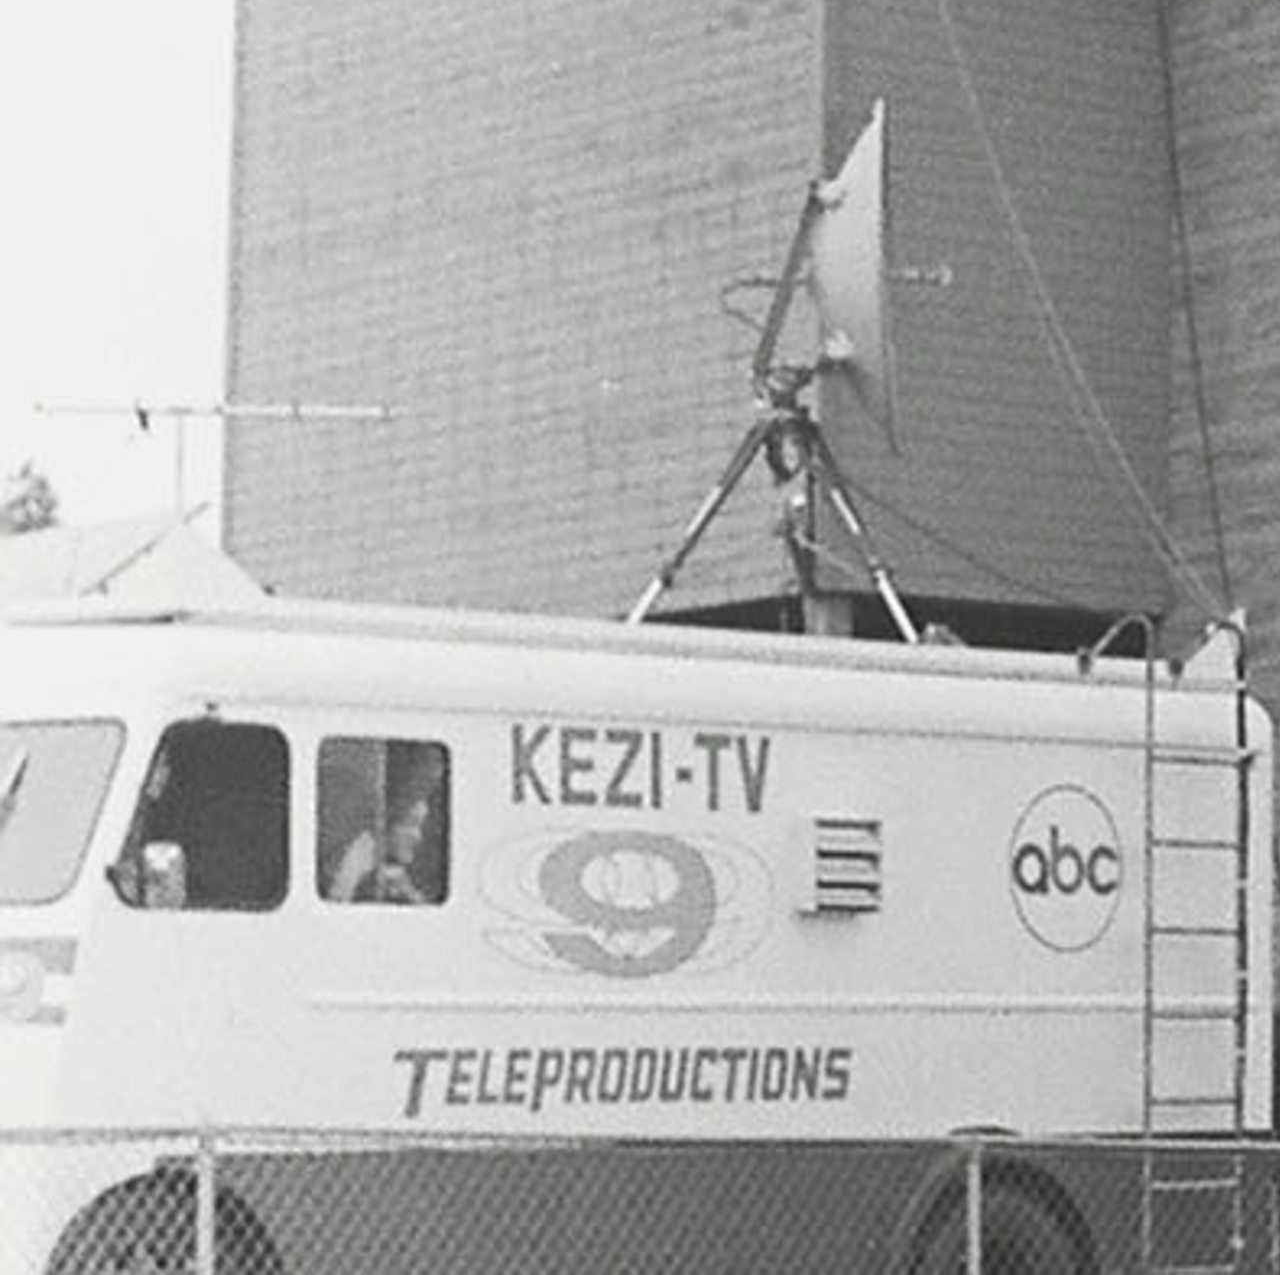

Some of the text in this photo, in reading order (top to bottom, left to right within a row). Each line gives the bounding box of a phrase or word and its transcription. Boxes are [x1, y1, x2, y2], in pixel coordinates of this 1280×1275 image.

[510, 723, 771, 813] KEZI-TV
[1012, 825, 1120, 897] abc
[538, 829, 717, 978] 9
[393, 1045, 853, 1119] TELEPRODUCTIONS
